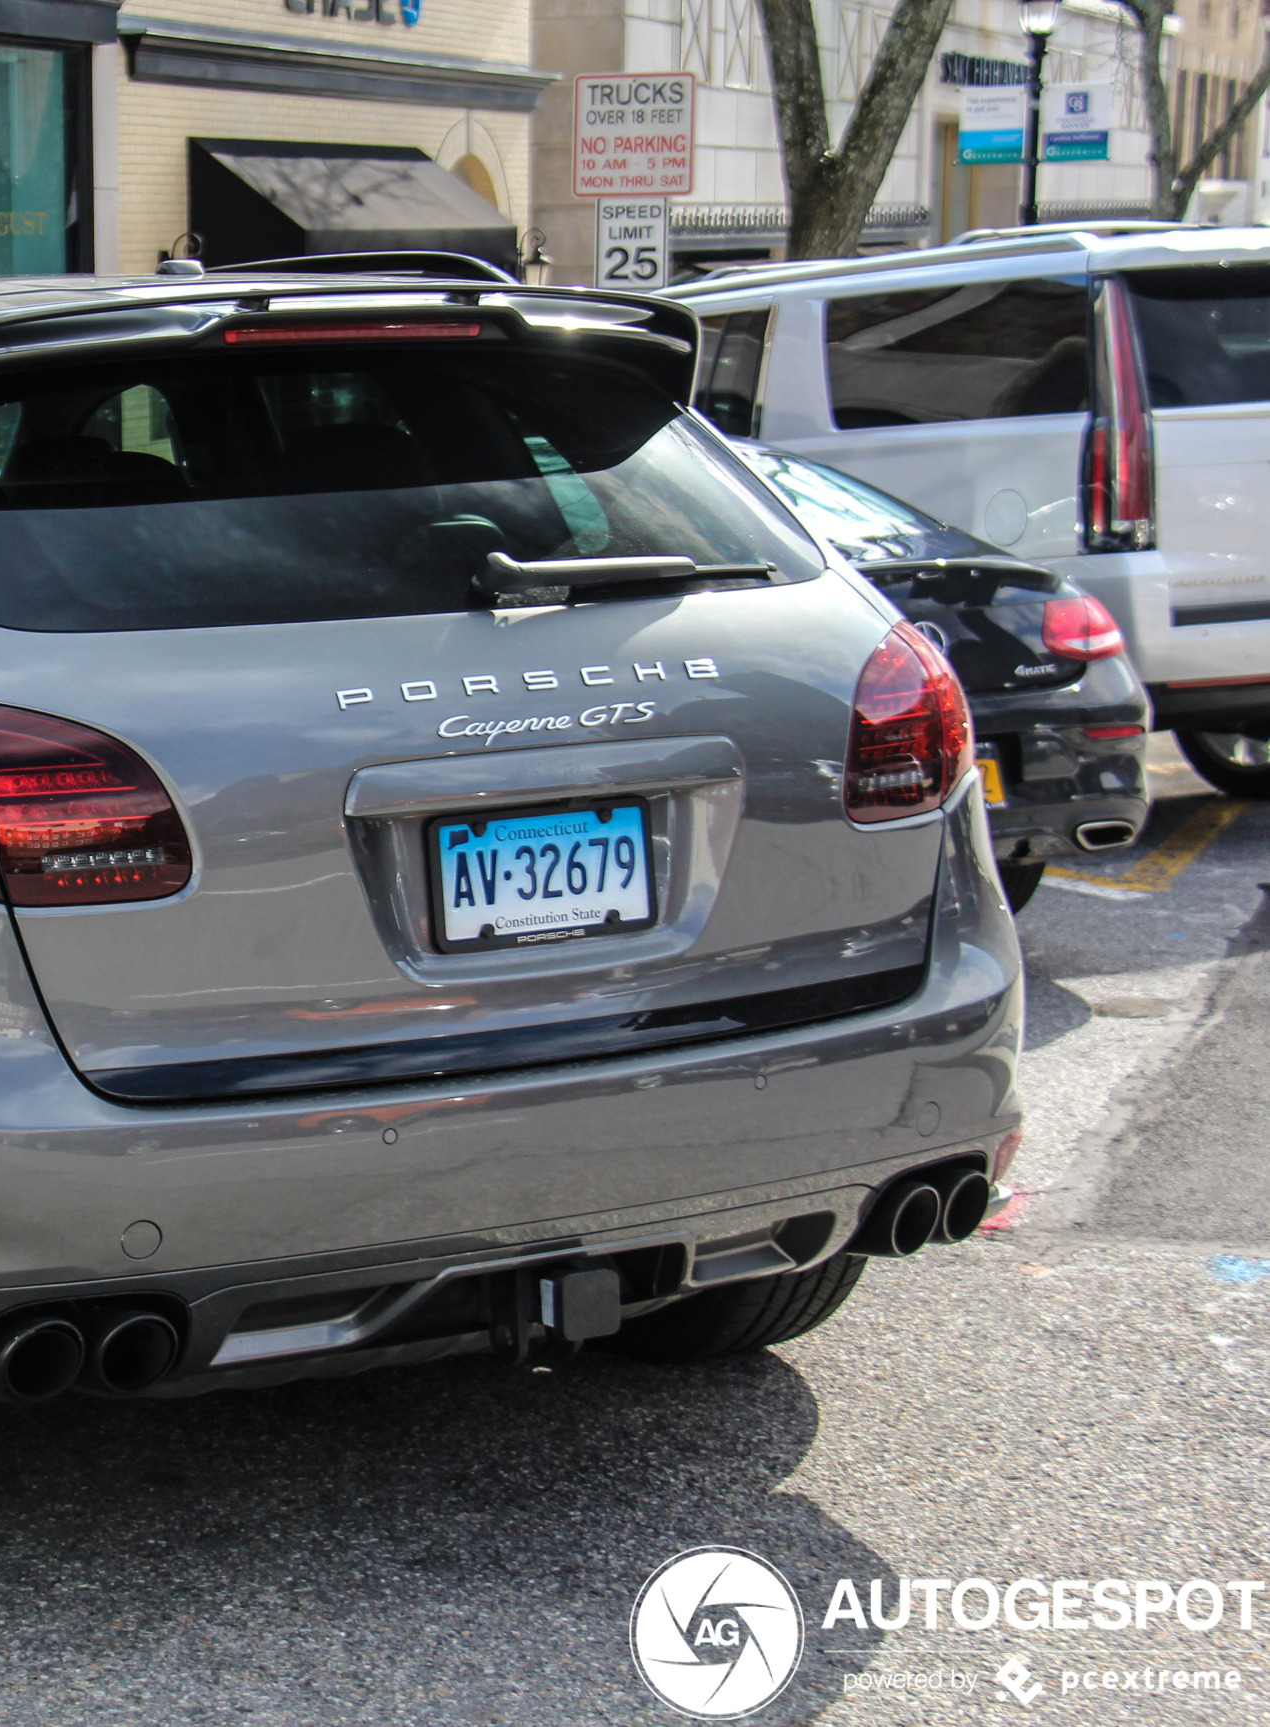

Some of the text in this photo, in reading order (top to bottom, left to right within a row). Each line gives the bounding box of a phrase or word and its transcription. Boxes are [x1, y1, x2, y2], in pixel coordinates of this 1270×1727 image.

[587, 82, 684, 106] TRUCKS
[586, 108, 683, 125] OVER 18 FEET
[581, 134, 686, 155] NO PARKING
[581, 159, 596, 171] 10
[602, 158, 627, 170] AM
[647, 158, 656, 170] 5
[662, 157, 686, 169] PM
[580, 174, 685, 188] MON THRU SAT
[602, 205, 662, 220] SPEED
[608, 225, 654, 240] LIMIT
[603, 245, 658, 281] 25
[336, 657, 719, 710] PORSCHE
[437, 701, 656, 747] Cayenne GTS
[495, 821, 589, 842] Connecticut
[495, 907, 601, 930] Constitution State
[516, 928, 586, 944] PORSCHE
